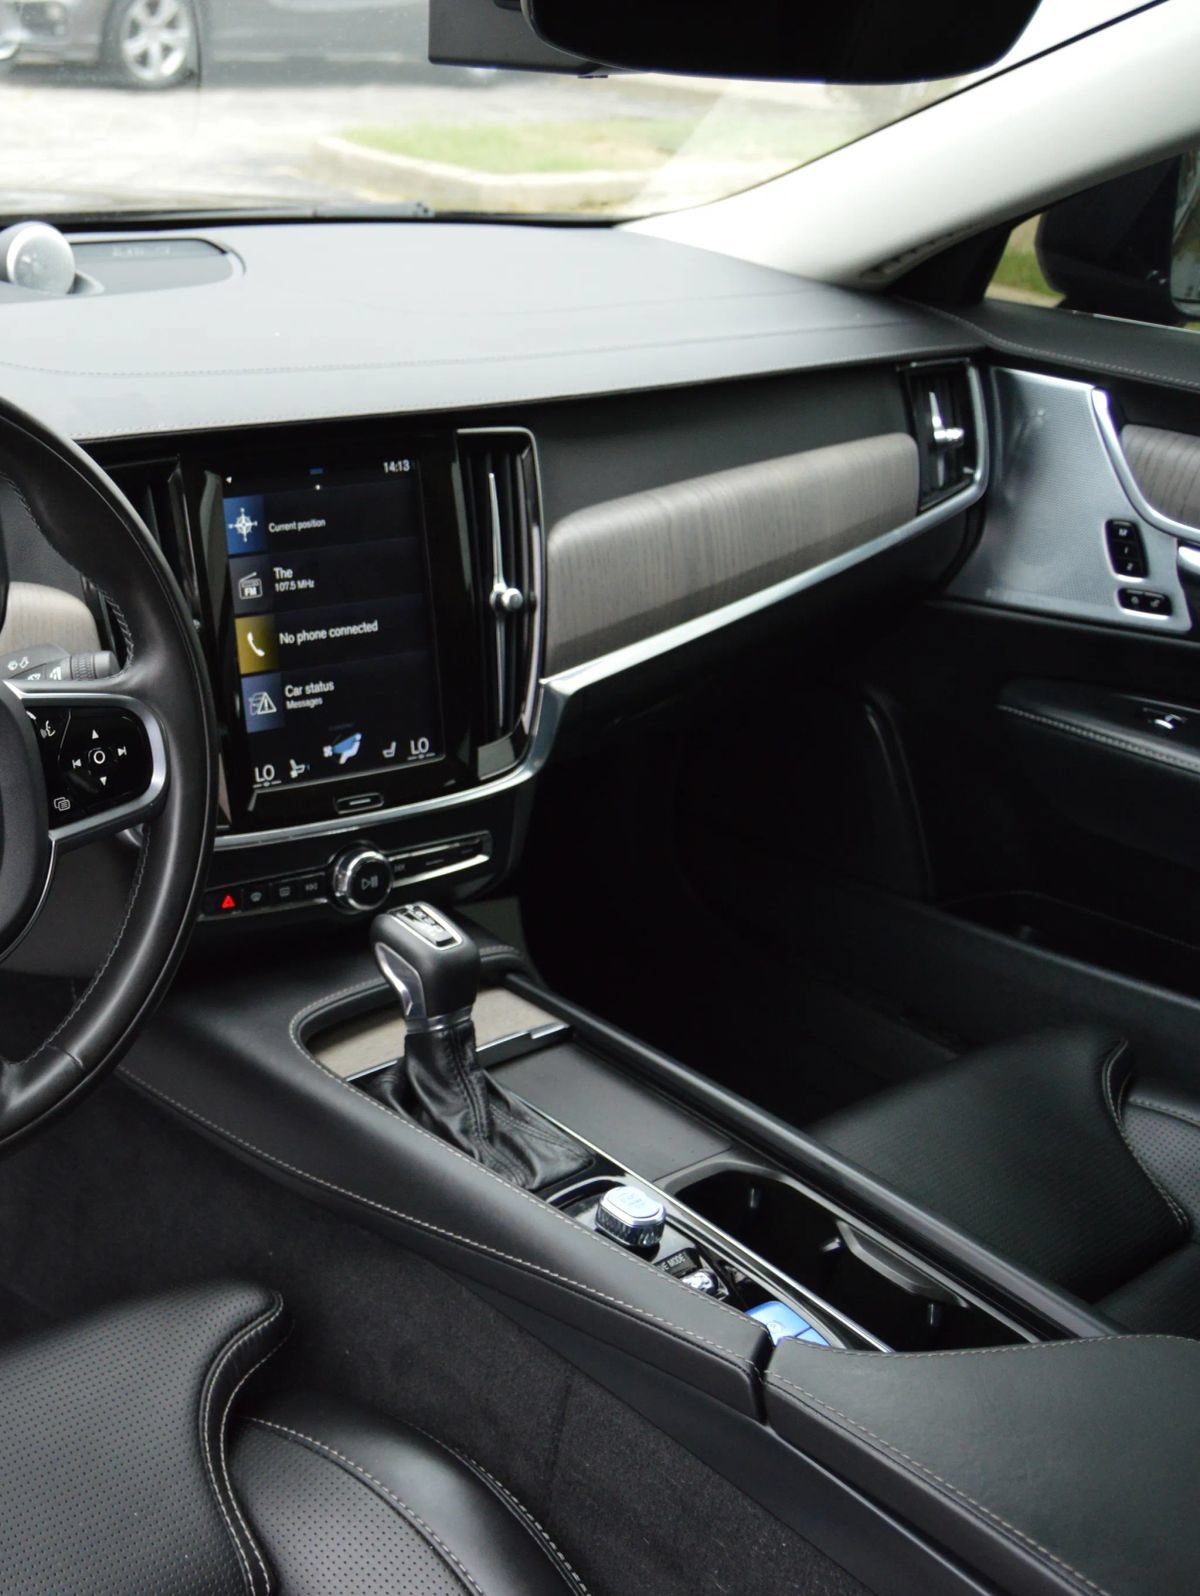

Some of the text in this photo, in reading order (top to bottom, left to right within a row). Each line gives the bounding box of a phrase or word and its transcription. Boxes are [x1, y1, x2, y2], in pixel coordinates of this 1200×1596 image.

[383, 459, 410, 473] 14:13
[268, 518, 326, 532] Current position
[273, 567, 294, 580] The
[279, 620, 378, 645] No phone connected
[285, 681, 334, 697] Car status
[286, 697, 323, 709] Messages
[410, 737, 430, 755] LO
[254, 764, 276, 782] LO
[666, 1251, 688, 1268] MODE
